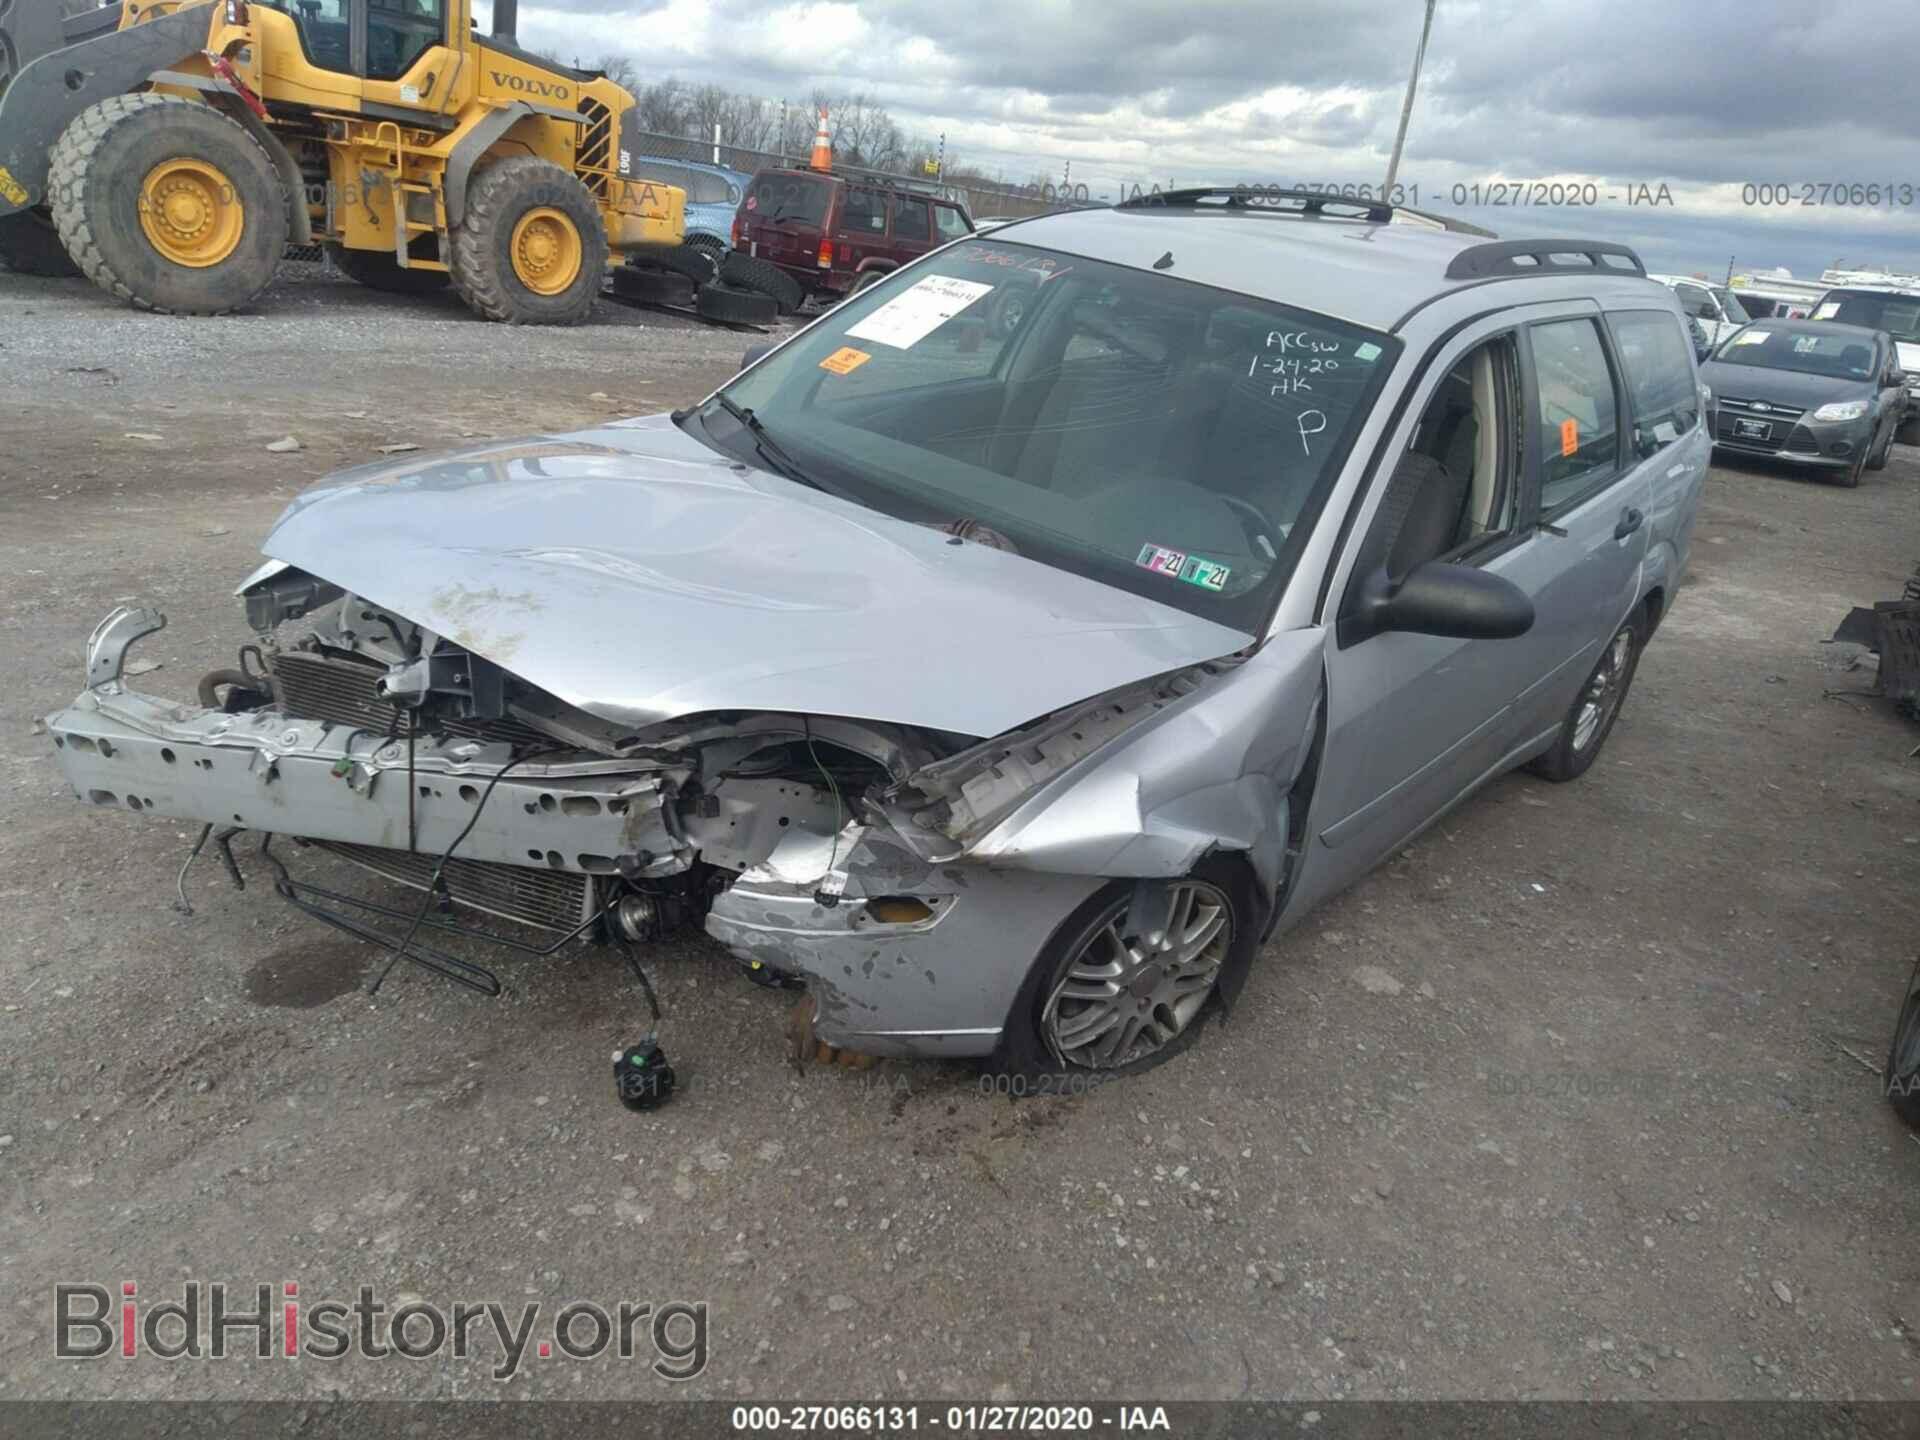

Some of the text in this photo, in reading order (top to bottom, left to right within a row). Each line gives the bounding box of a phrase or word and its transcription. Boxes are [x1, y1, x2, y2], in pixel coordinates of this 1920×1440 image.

[490, 71, 569, 100] VOLVO
[1297, 409, 1327, 456] P
[1165, 553, 1183, 573] 21
[1208, 567, 1226, 587] 21
